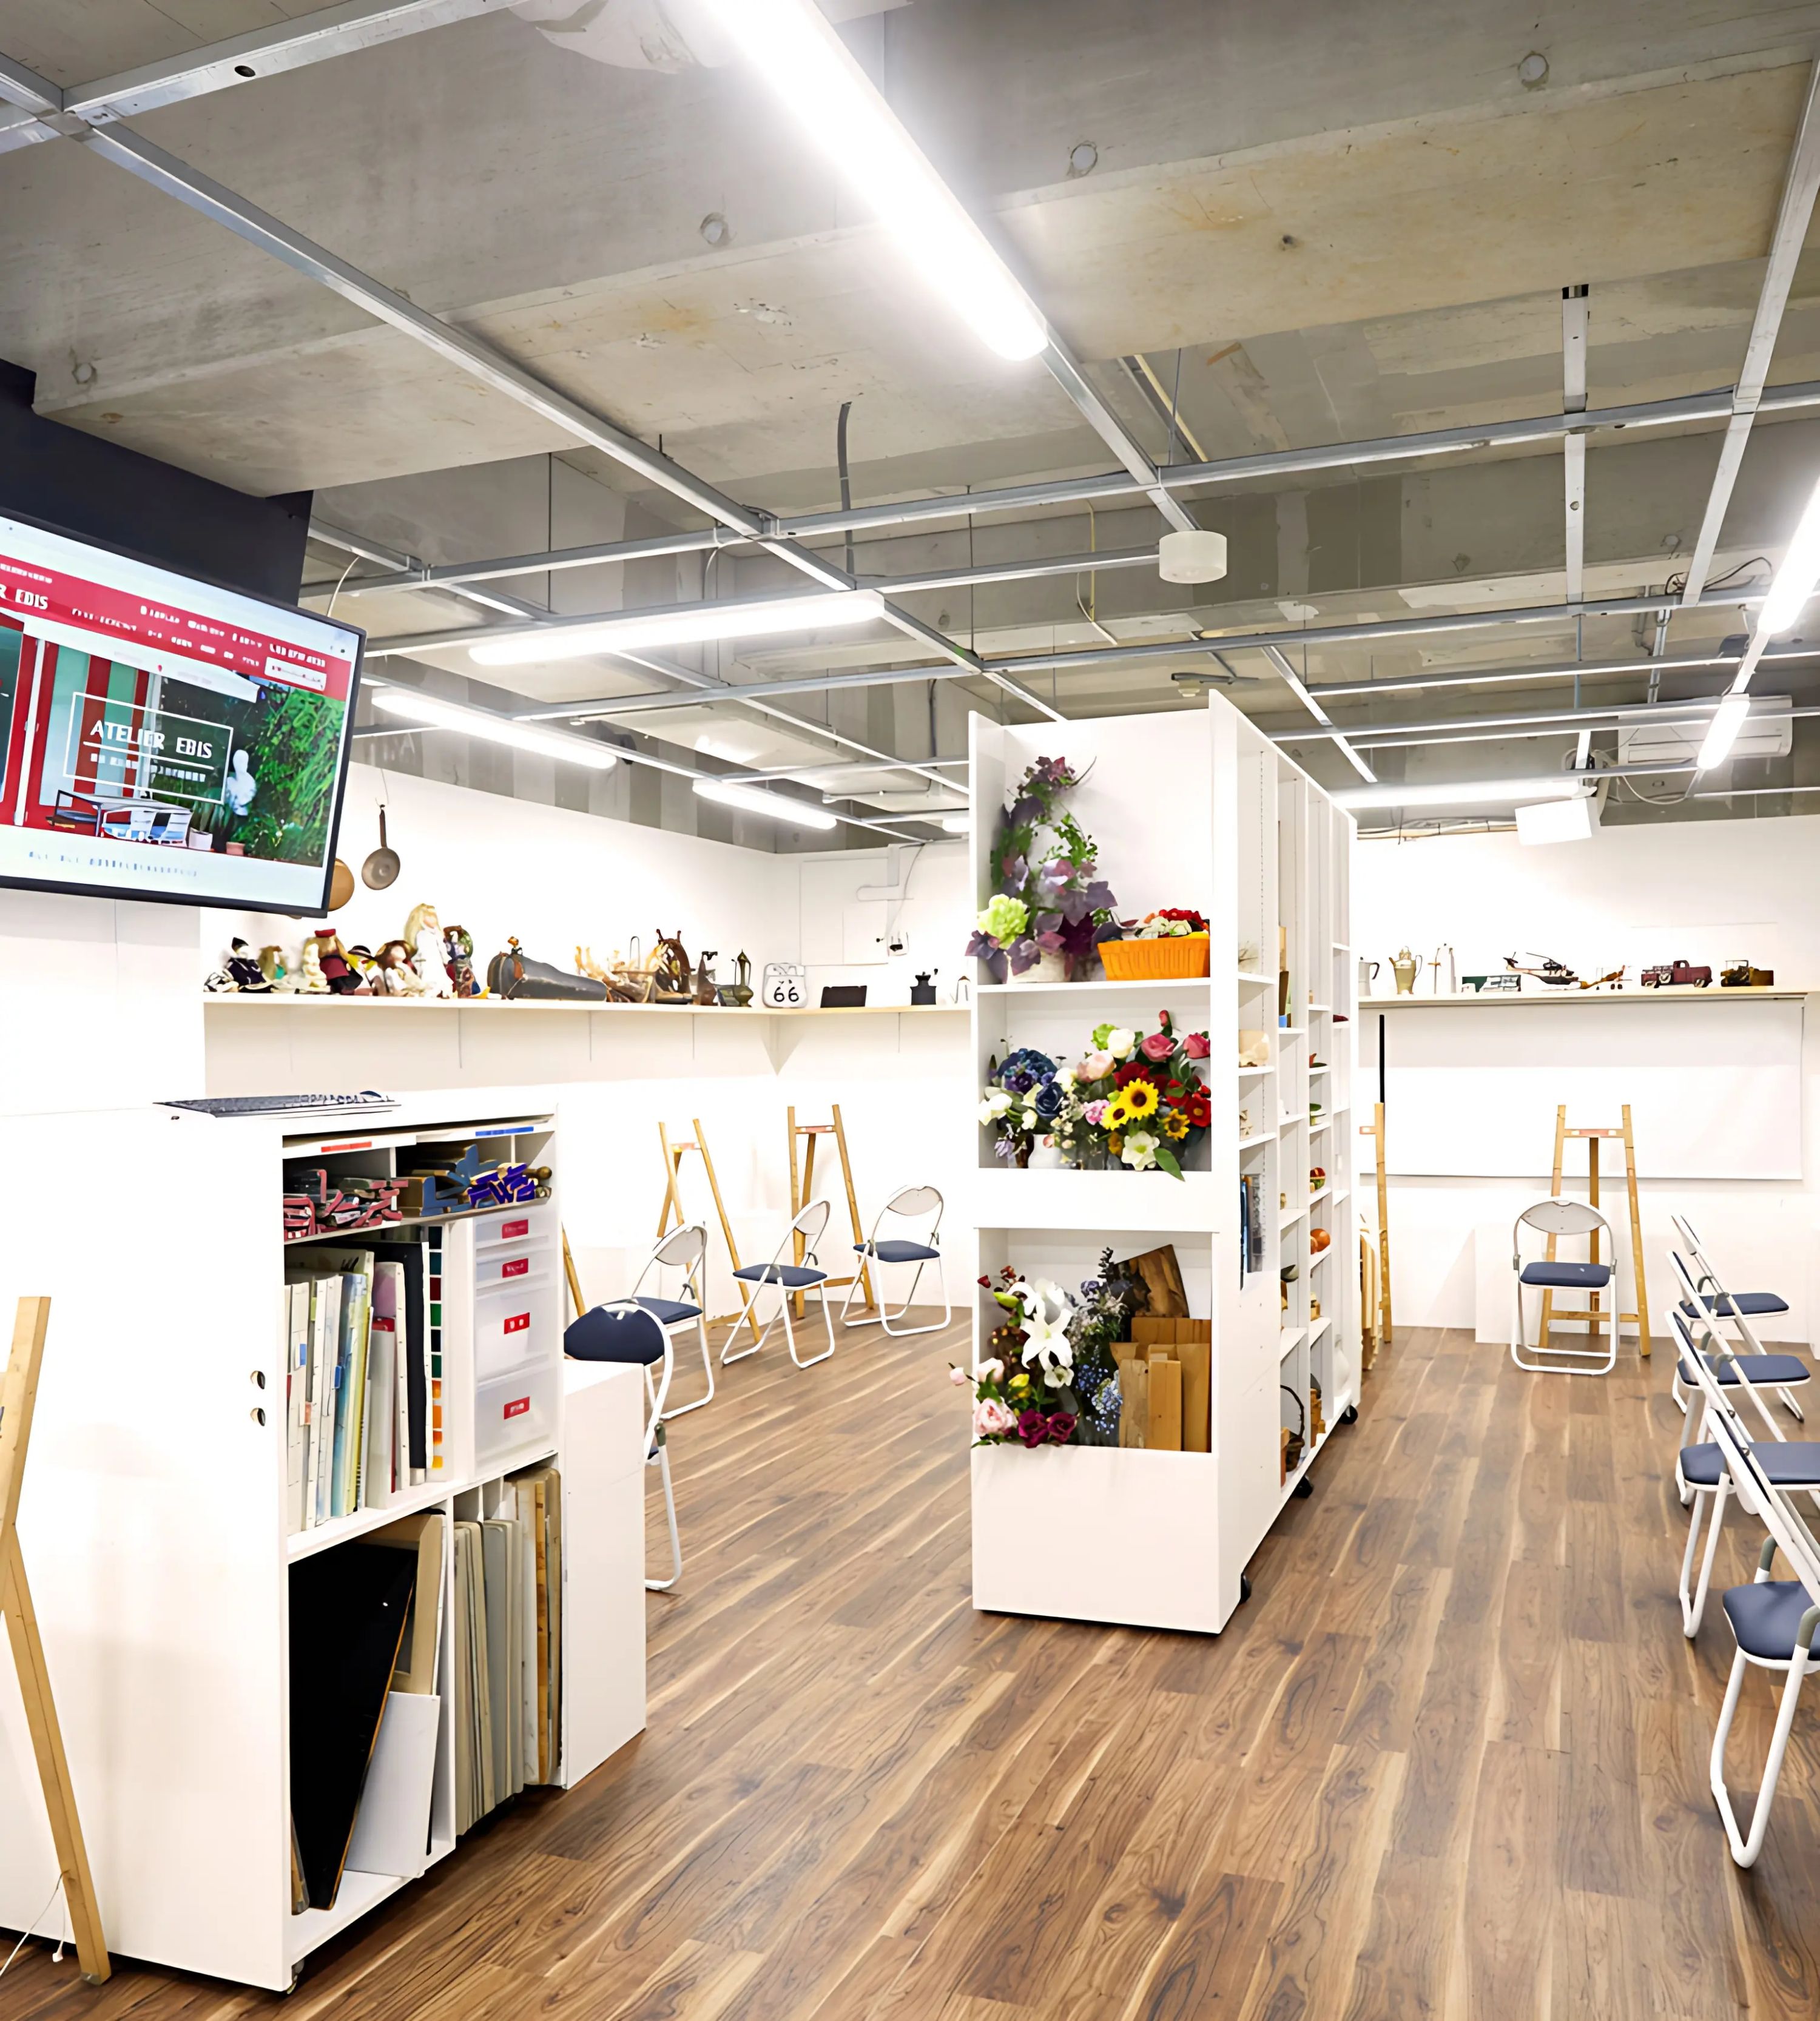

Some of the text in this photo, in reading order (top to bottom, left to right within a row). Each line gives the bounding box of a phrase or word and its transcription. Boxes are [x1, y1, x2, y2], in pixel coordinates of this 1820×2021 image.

[90, 720, 213, 759] ATELIER EBIS
[774, 986, 800, 1003] 66
